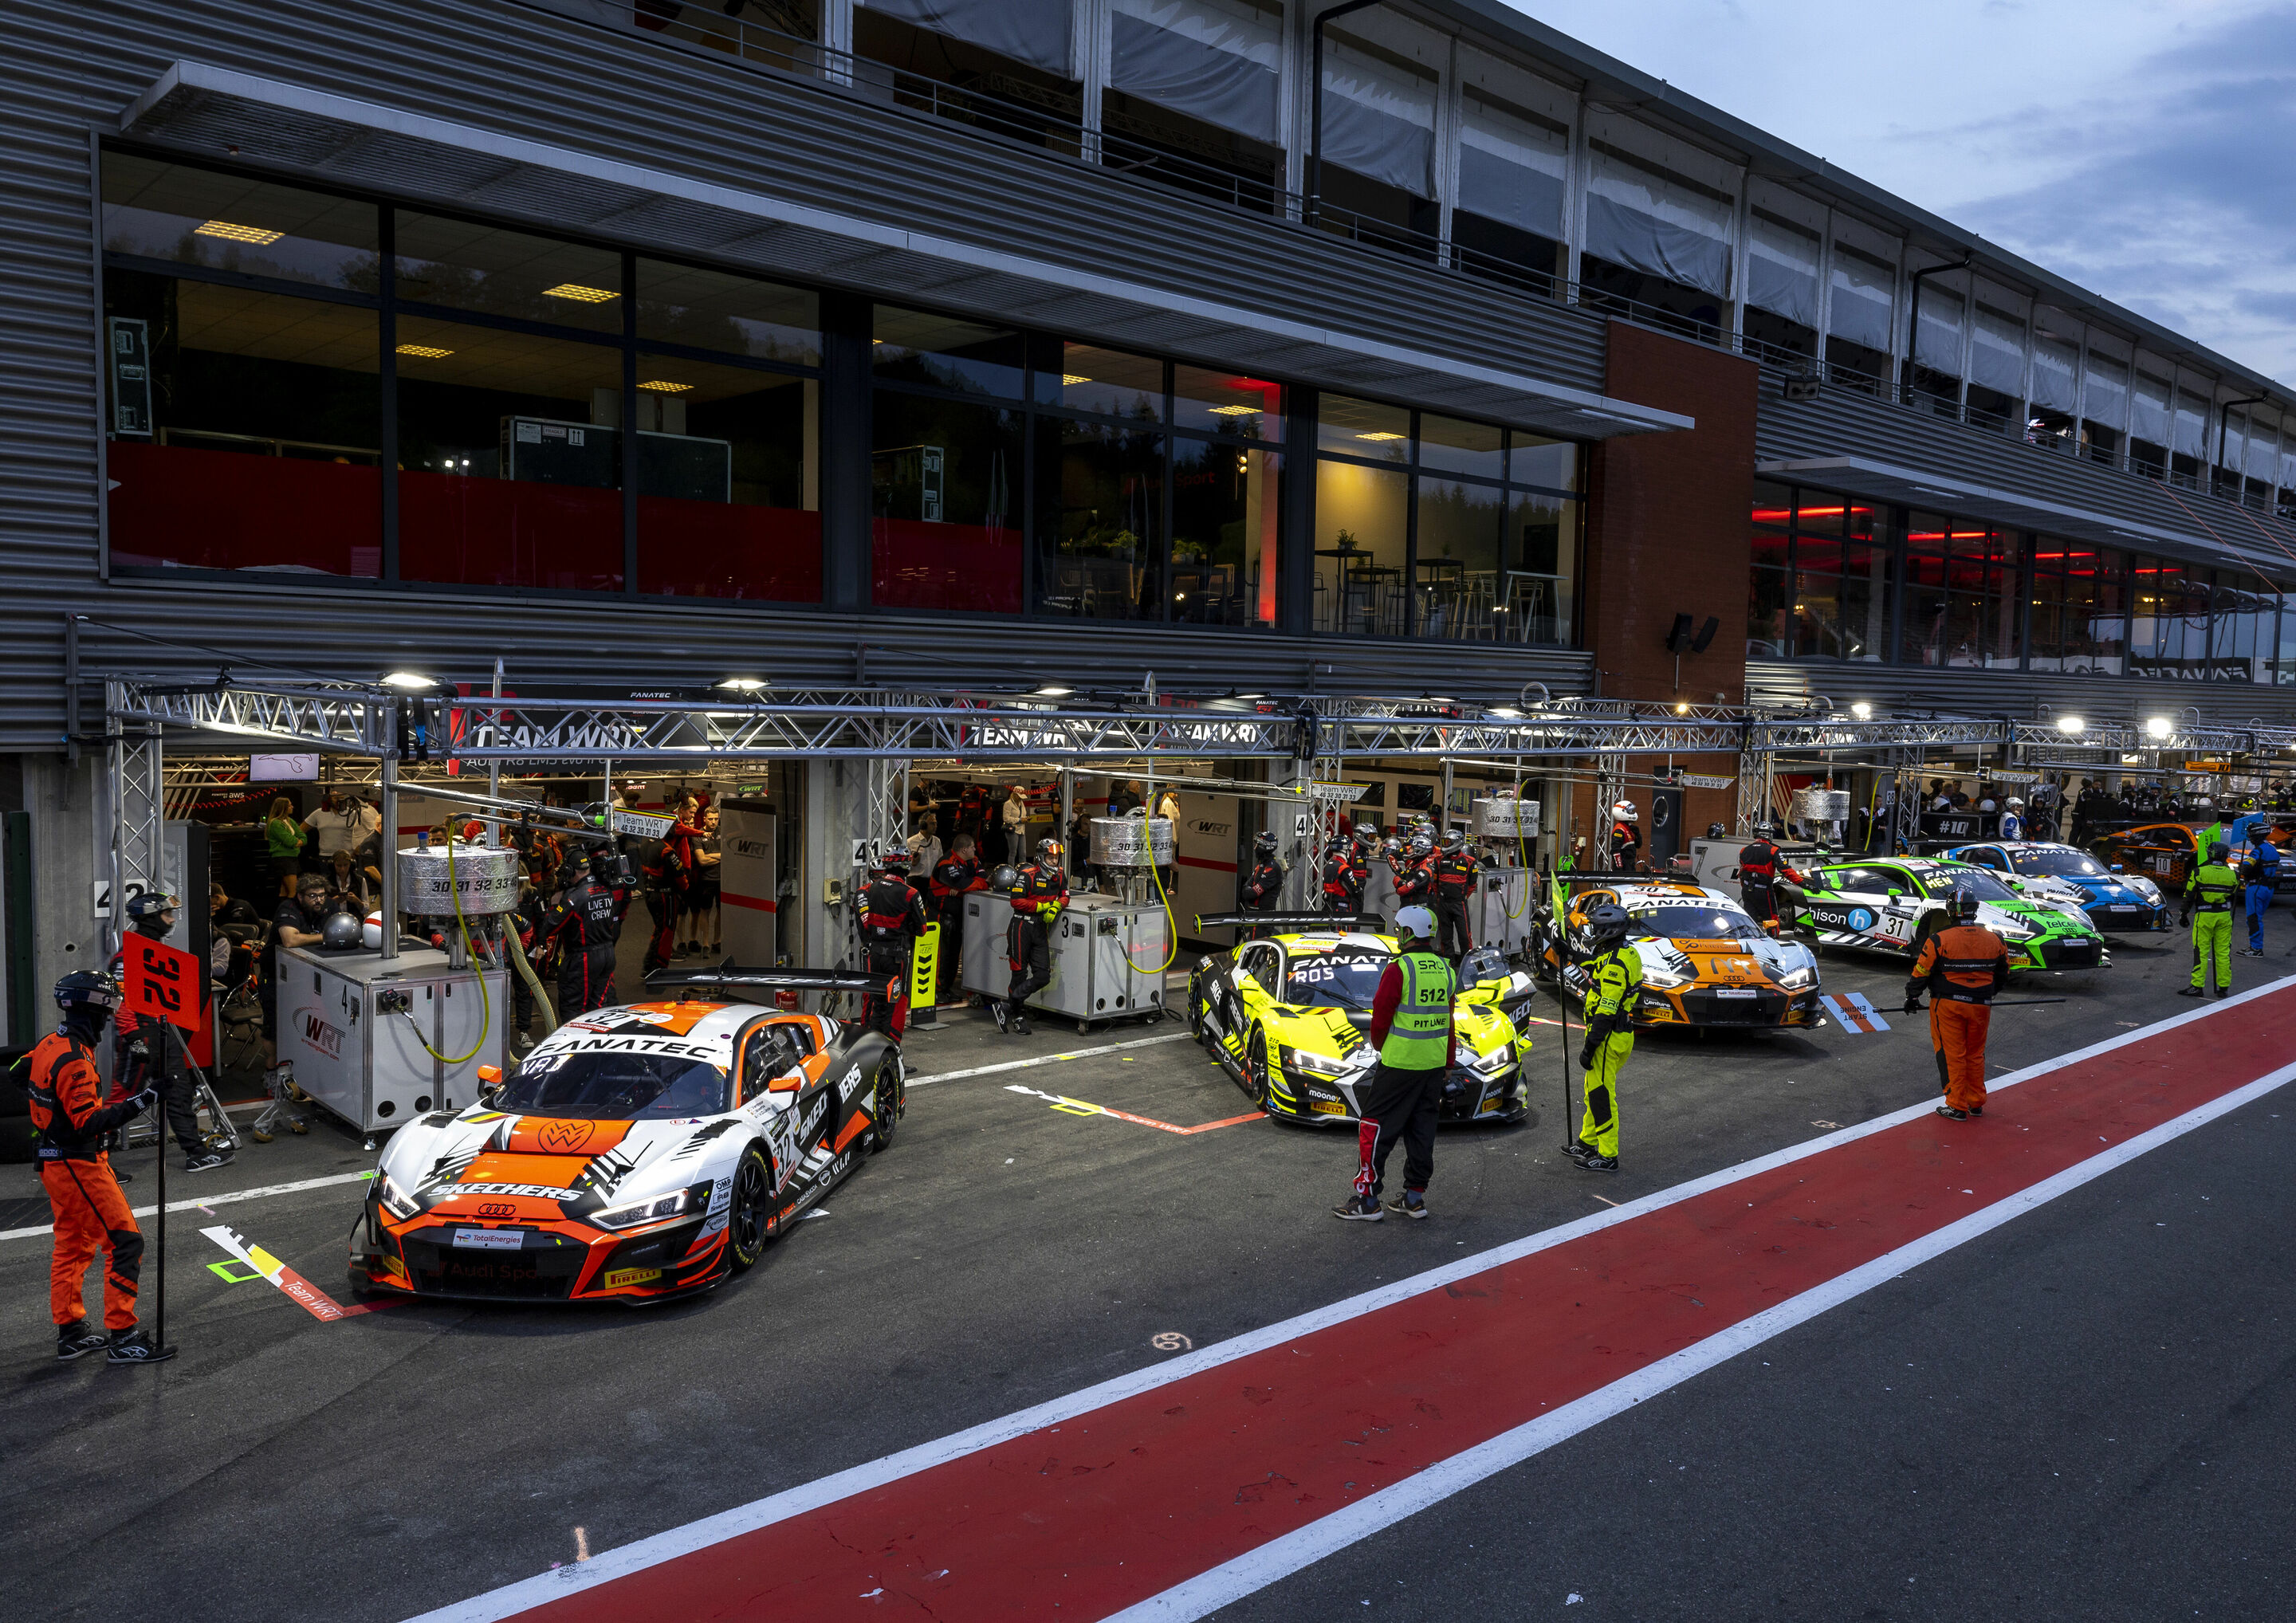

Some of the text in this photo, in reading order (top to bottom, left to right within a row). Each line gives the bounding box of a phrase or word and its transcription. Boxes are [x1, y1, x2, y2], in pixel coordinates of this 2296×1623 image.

[474, 725, 631, 748] TEAM WRT
[972, 726, 1065, 745] TEAM WR
[1887, 792, 1895, 804] 38
[622, 815, 663, 830] Team WRT
[1198, 821, 1231, 834] WRT
[652, 828, 660, 837] 33
[737, 840, 769, 855] WRT
[855, 841, 879, 863] 41
[2158, 859, 2168, 871] 10
[432, 881, 451, 893] 30
[456, 881, 470, 892] 31
[474, 879, 493, 891] 32
[495, 878, 509, 890] 33
[1925, 876, 1954, 890] MEN
[588, 898, 613, 910] LIVE TV
[1626, 899, 1735, 910] FANATEC
[591, 909, 611, 921] CREW
[1062, 915, 1069, 938] 3
[1885, 917, 1905, 937] 31
[1295, 967, 1335, 983] ROS
[1642, 964, 1669, 973] OFGO
[144, 948, 180, 1012] 32
[341, 984, 348, 1015] 4
[1419, 988, 1445, 1003] 512
[584, 1012, 631, 1025] 32
[1645, 1009, 1671, 1018] PIRELLI
[1413, 1020, 1429, 1028] PIT
[306, 1014, 346, 1054] WRT
[533, 1039, 718, 1059] FANATEC
[1309, 1089, 1341, 1103] mooney
[1313, 1102, 1343, 1114] PIRELLI
[1124, 1114, 1193, 1134] Team WRT
[777, 1133, 792, 1178] 32
[427, 1182, 584, 1201] SKECHERS
[716, 1178, 732, 1190] OMP
[474, 1234, 521, 1244] TotalEnergies
[451, 1262, 494, 1279] Audi
[611, 1268, 656, 1285] PIRELLI
[285, 1281, 344, 1318] Team WRT
